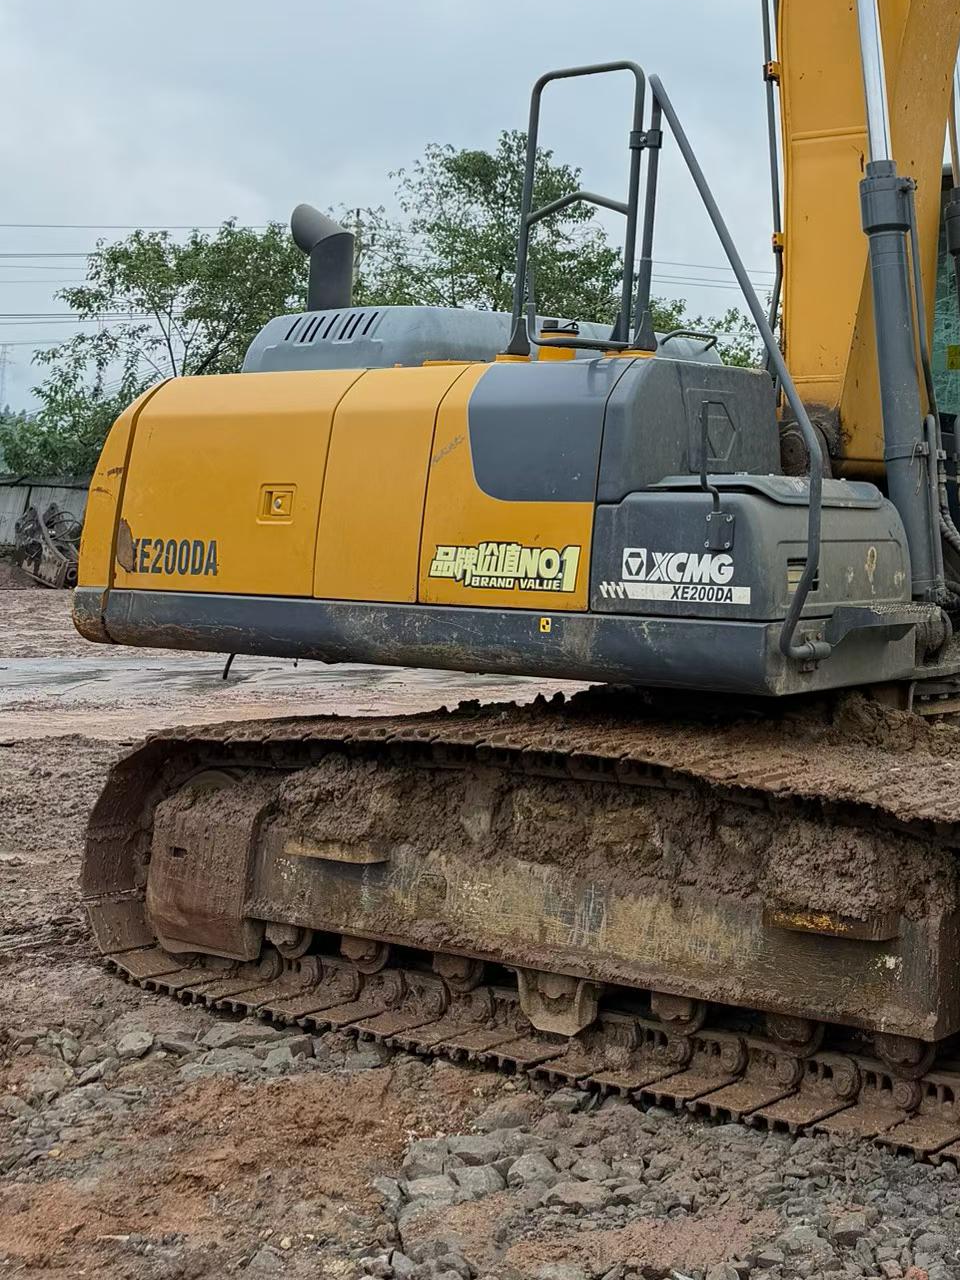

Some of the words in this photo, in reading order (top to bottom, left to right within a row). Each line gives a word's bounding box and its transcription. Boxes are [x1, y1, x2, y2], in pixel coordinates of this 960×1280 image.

[646, 552, 735, 585] XCMG
[471, 577, 514, 588] BRAND
[520, 578, 561, 591] VALUE
[671, 586, 733, 602] XE200DA
